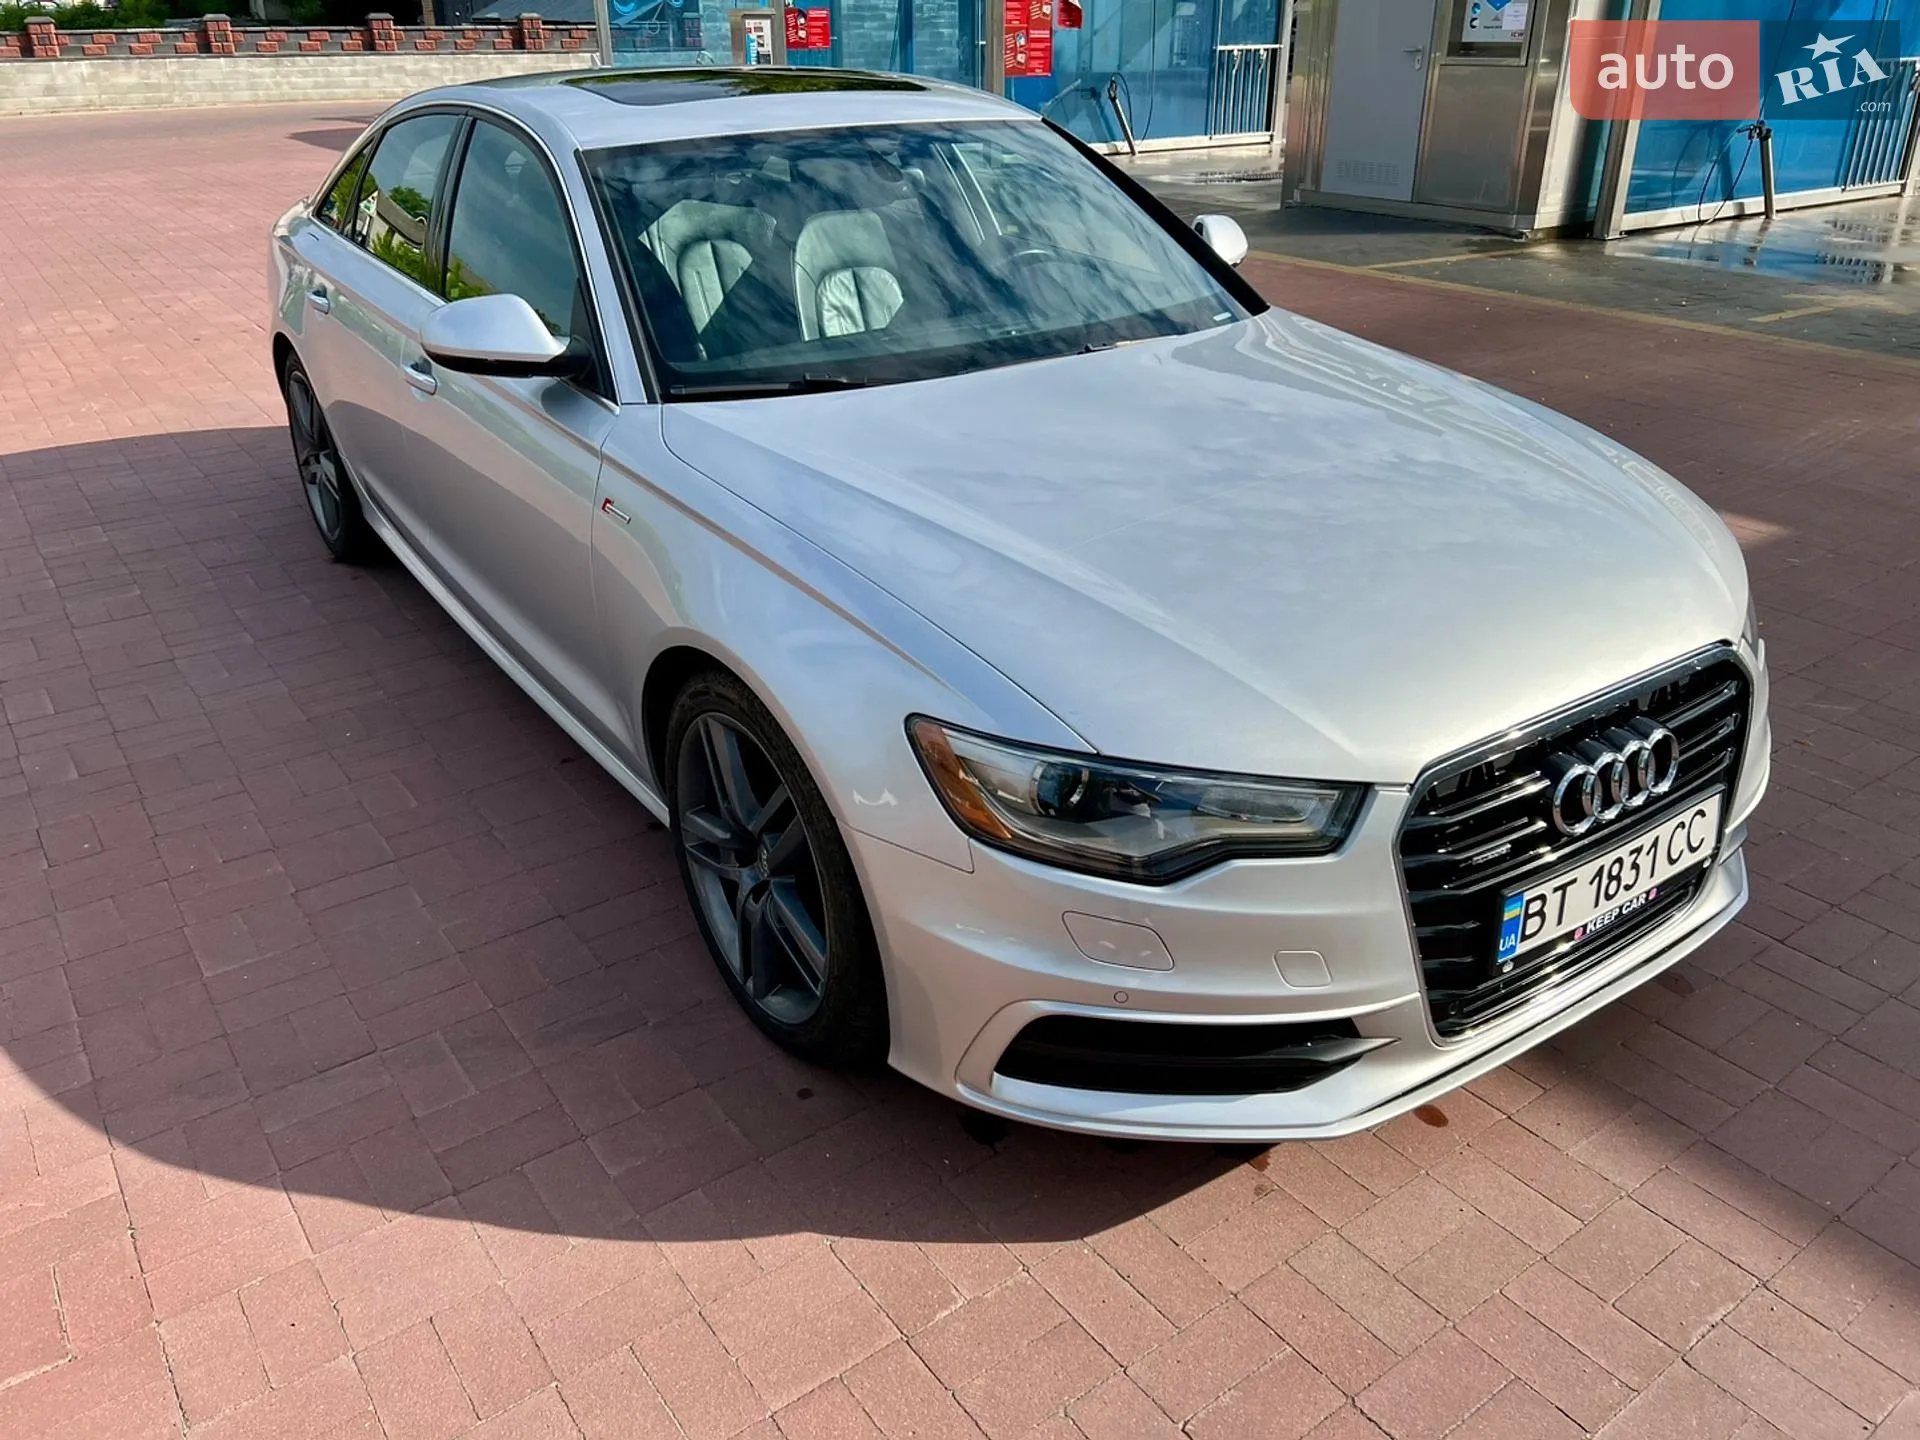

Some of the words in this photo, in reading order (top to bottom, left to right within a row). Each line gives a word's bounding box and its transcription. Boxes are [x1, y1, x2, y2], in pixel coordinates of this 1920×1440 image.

[1519, 877, 1578, 944] BT
[1588, 835, 1660, 909] 1831
[1666, 808, 1707, 866] CC
[1586, 907, 1620, 934] KEEP
[1621, 892, 1648, 915] CAR
[1499, 933, 1516, 951] UA
